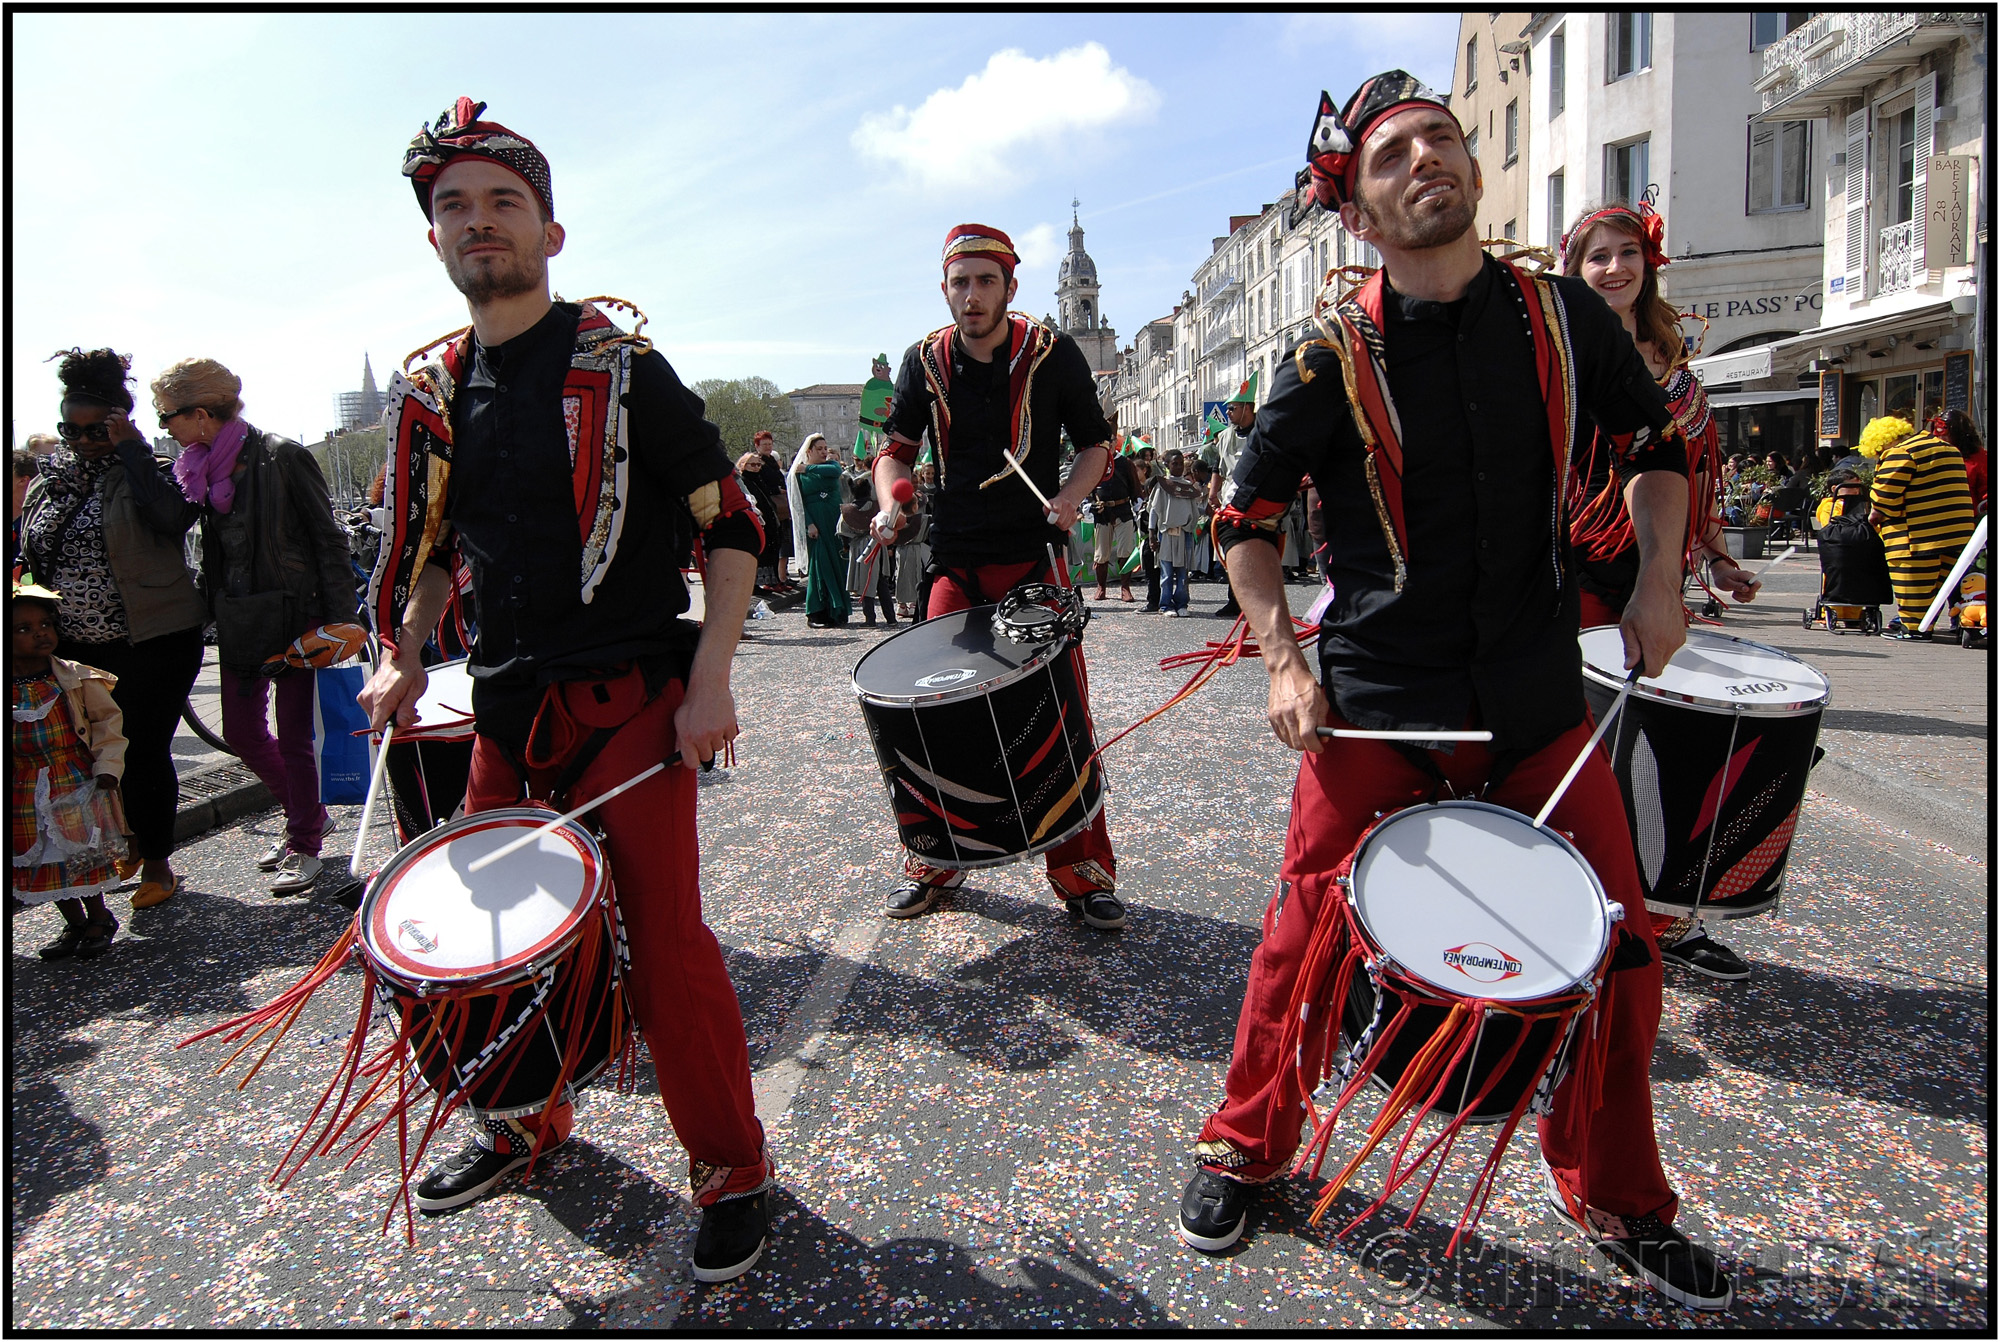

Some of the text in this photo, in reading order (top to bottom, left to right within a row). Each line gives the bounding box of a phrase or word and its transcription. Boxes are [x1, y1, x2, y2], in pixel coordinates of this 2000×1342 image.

[1935, 159, 1961, 171] BAR
[1933, 200, 1947, 222] 28
[1950, 160, 1962, 263] RESTAURANT
[1691, 302, 1719, 320] LE
[1725, 681, 1788, 696] GOPE
